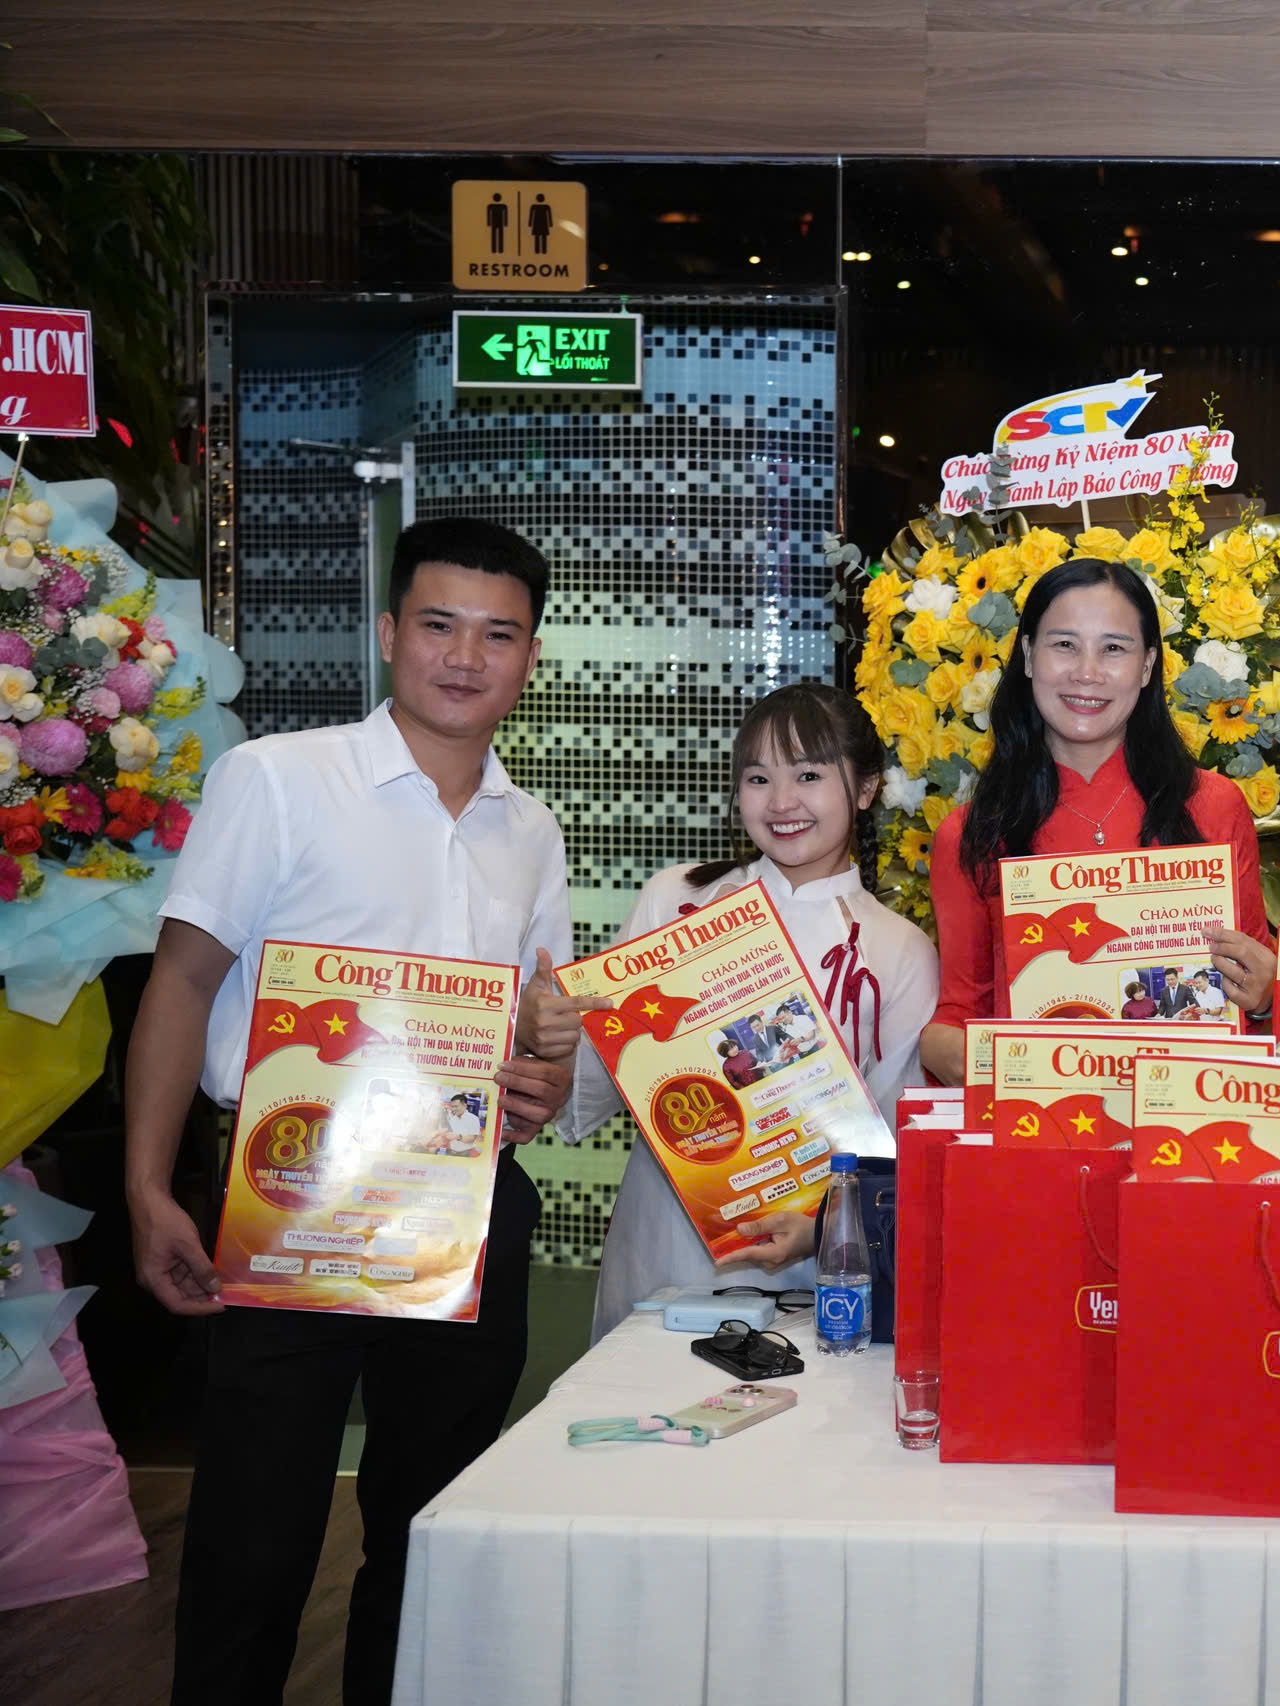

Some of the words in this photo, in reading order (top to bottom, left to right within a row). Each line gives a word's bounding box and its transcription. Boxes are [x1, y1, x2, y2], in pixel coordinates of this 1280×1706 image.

[468, 263, 570, 278] RESTROOM
[555, 327, 611, 351] EXIT
[555, 352, 574, 370] LỐI
[575, 354, 611, 371] THOÁT
[1006, 396, 1149, 441] SCTV
[944, 456, 993, 479] Chúc
[1056, 444, 1080, 469] Kỷ
[1085, 440, 1139, 465] Niệm
[1144, 434, 1175, 456] 80
[1048, 476, 1079, 503] Lập
[1082, 471, 1115, 495] Báo
[1120, 468, 1163, 493] Công
[1050, 862, 1122, 892] Công
[1121, 856, 1225, 884] Thương
[1141, 907, 1178, 921] CHÀO
[1183, 903, 1223, 917] MỪNG
[603, 946, 675, 981] Công
[664, 898, 767, 953] Thương
[1131, 926, 1144, 937] ĐẠI
[1145, 923, 1158, 936] HỘI
[1160, 924, 1171, 934] THI
[1172, 923, 1187, 932] ĐUA
[1188, 919, 1202, 931] YÊU
[1107, 941, 1132, 953] NGÀNH
[1134, 940, 1154, 951] CÔNG
[1156, 938, 1184, 949] THƯƠNG
[1186, 934, 1200, 947] LẦN
[701, 959, 739, 984] CHÀO
[739, 940, 779, 965] MỪNG
[315, 954, 394, 995] Công
[395, 961, 506, 1007] Thương
[699, 988, 713, 1000] ĐẠI
[711, 982, 726, 994] HỘI
[724, 976, 738, 988] THI
[736, 969, 752, 983] ĐUA
[750, 963, 766, 976] YÊU
[764, 953, 785, 969] NƯỚC
[683, 1006, 709, 1025] NGÀNH
[708, 997, 729, 1013] CÔNG
[727, 984, 756, 1004] THƯƠNG
[754, 977, 770, 991] LẦN
[768, 969, 784, 983] THỨ
[782, 966, 791, 976] IV
[1075, 994, 1115, 1014] 2/10/2025
[405, 1019, 447, 1035] CHÀO
[451, 1024, 496, 1040] MỪNG
[423, 1038, 436, 1049] THI
[438, 1040, 453, 1051] ĐUA
[455, 1040, 470, 1052] YÊU
[472, 1043, 494, 1055] NƯỚC
[416, 1054, 447, 1067] THƯƠNG
[449, 1055, 465, 1069] LẦN
[467, 1058, 483, 1070] THỨ
[484, 1060, 492, 1070] IV
[1052, 1044, 1134, 1086] Công
[660, 1082, 715, 1135] 80
[709, 1112, 727, 1123] năm
[821, 1296, 860, 1320] ICY
